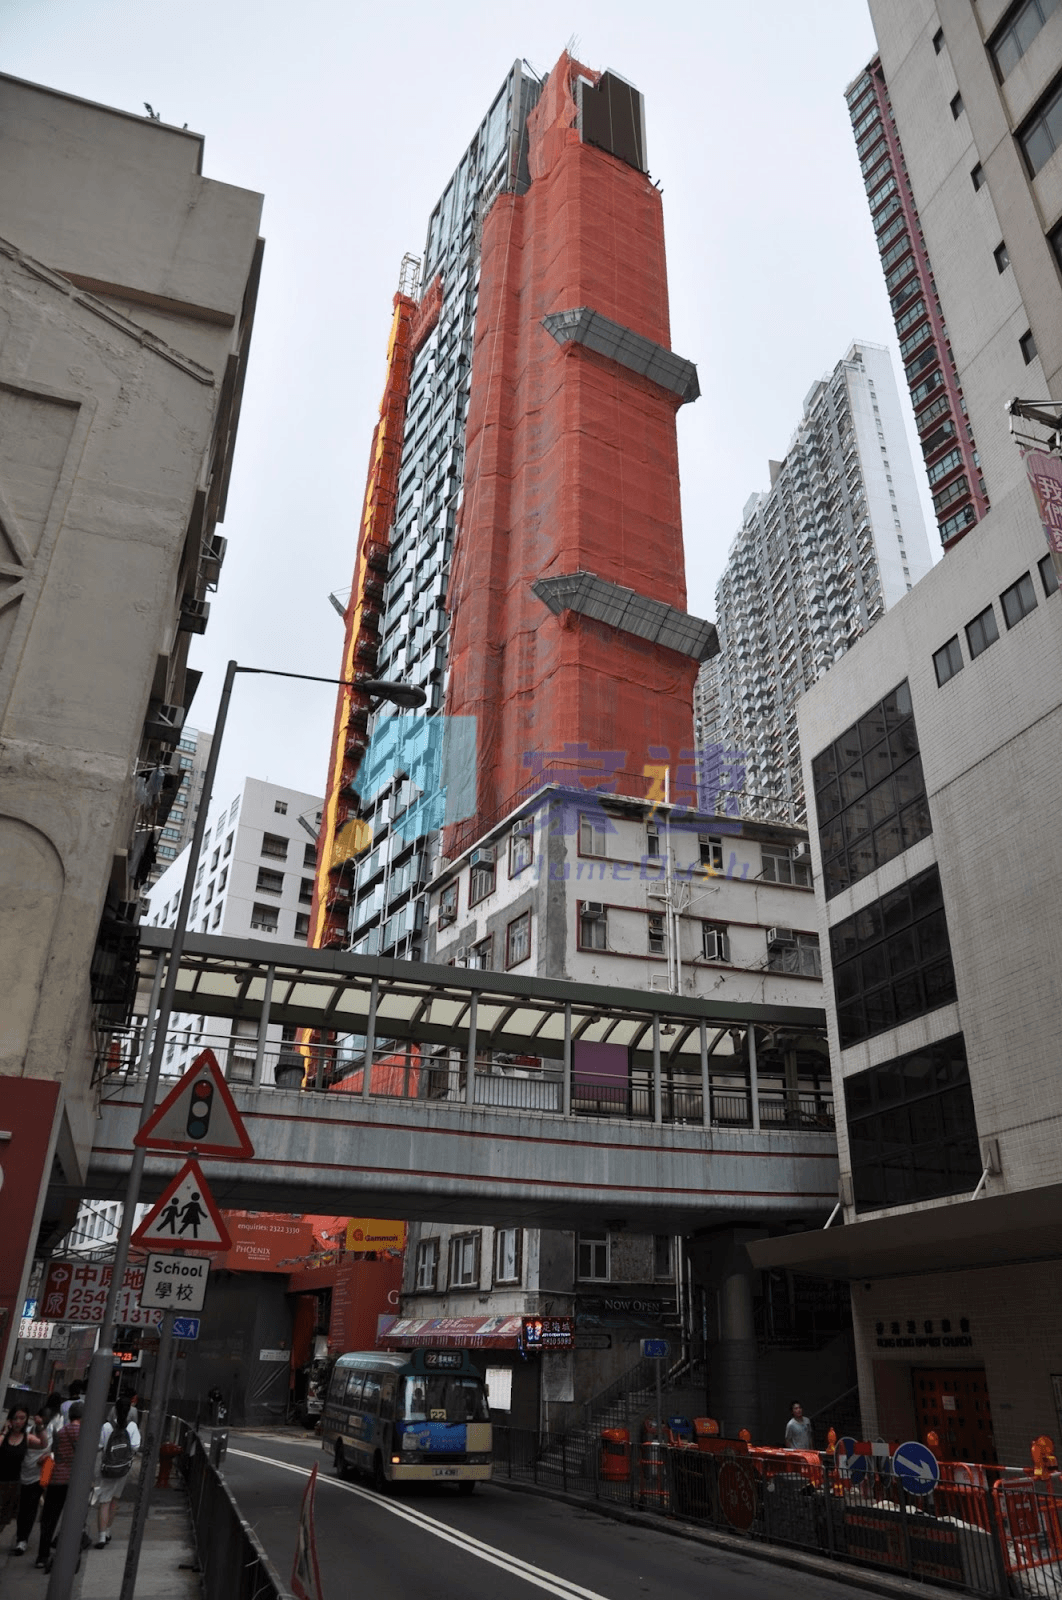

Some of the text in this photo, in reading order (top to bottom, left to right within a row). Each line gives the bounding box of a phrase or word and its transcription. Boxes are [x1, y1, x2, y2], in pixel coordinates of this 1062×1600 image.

[238, 1223, 269, 1231] enquiries:
[365, 1234, 398, 1242] Gammon
[236, 1245, 271, 1255] PHOENIX
[152, 1261, 203, 1277] School
[72, 1289, 107, 1304] 254
[155, 1282, 194, 1302] 學校
[605, 1300, 660, 1312] NOW OPEN
[68, 1305, 106, 1320] 253
[426, 1354, 437, 1364] 22
[431, 1411, 445, 1420] 22
